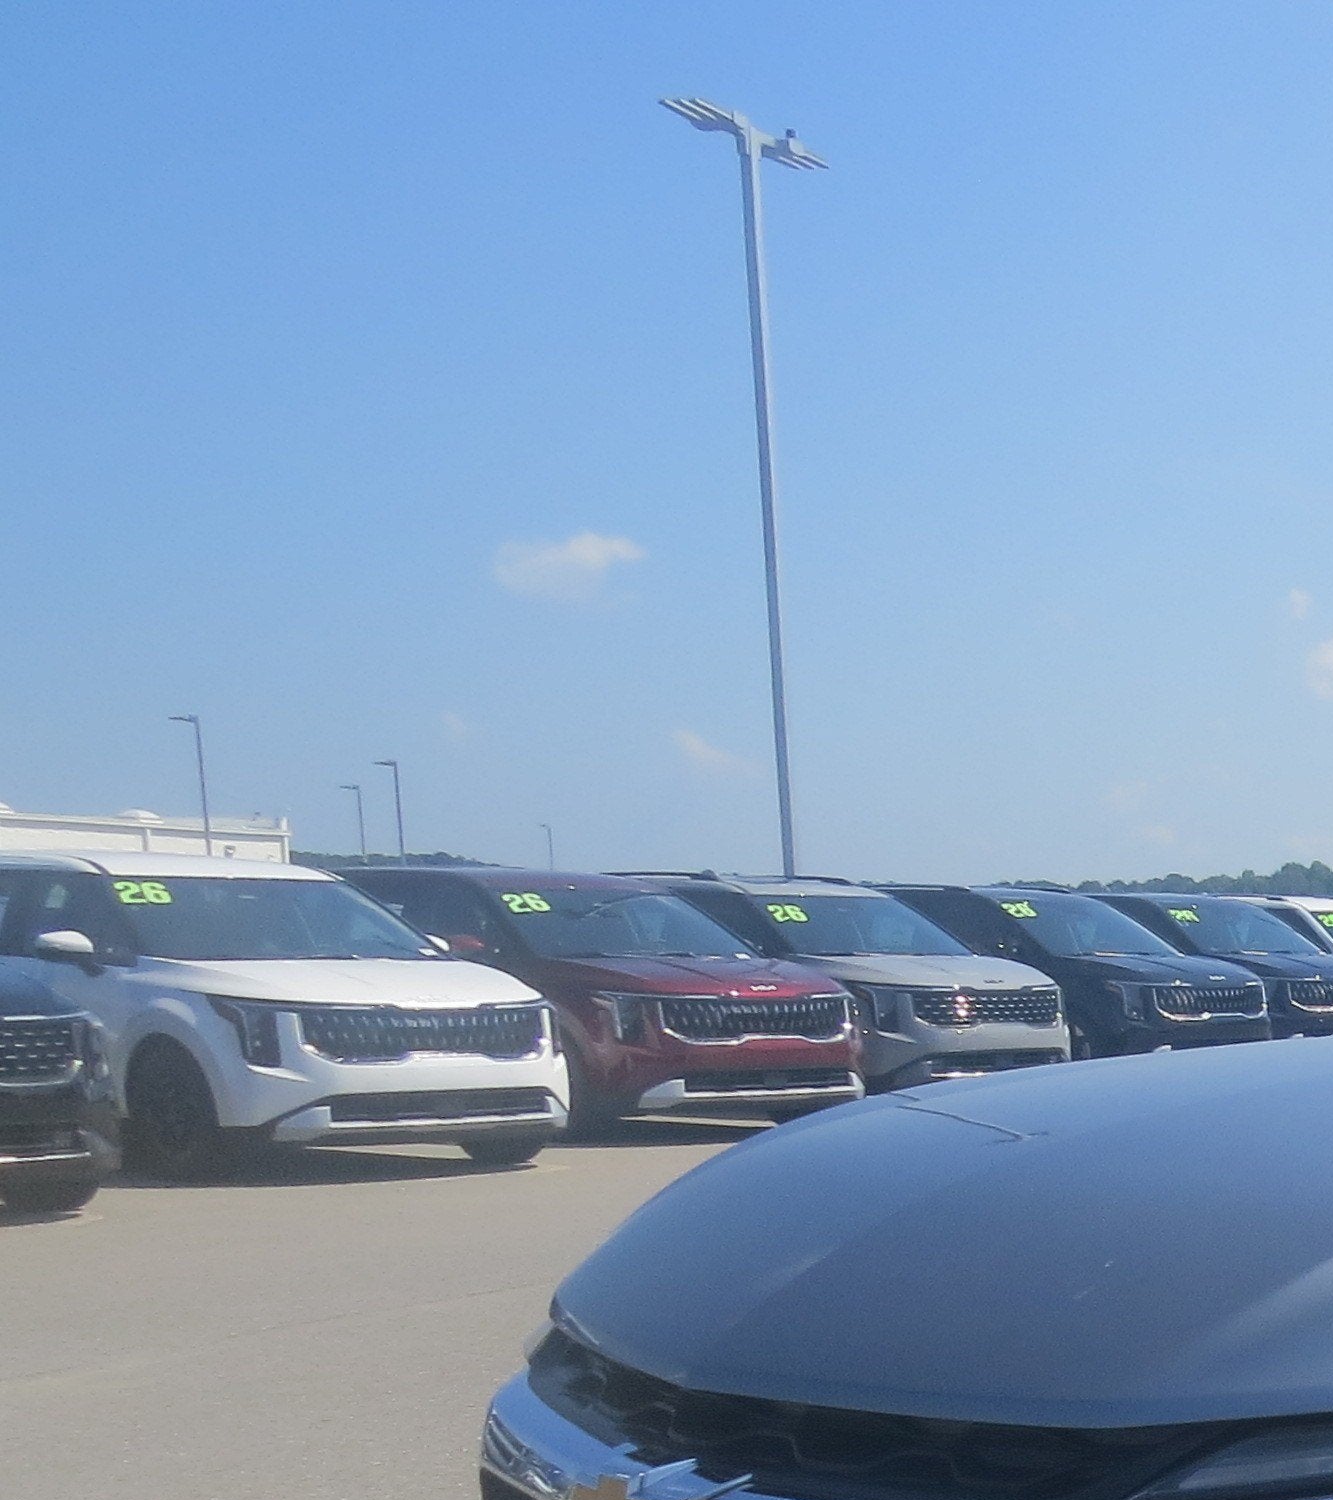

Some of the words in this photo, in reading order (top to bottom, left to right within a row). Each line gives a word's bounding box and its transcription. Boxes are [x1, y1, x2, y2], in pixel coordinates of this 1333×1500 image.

[112, 880, 172, 904] 26
[502, 893, 549, 913] 26
[767, 904, 808, 922] 26
